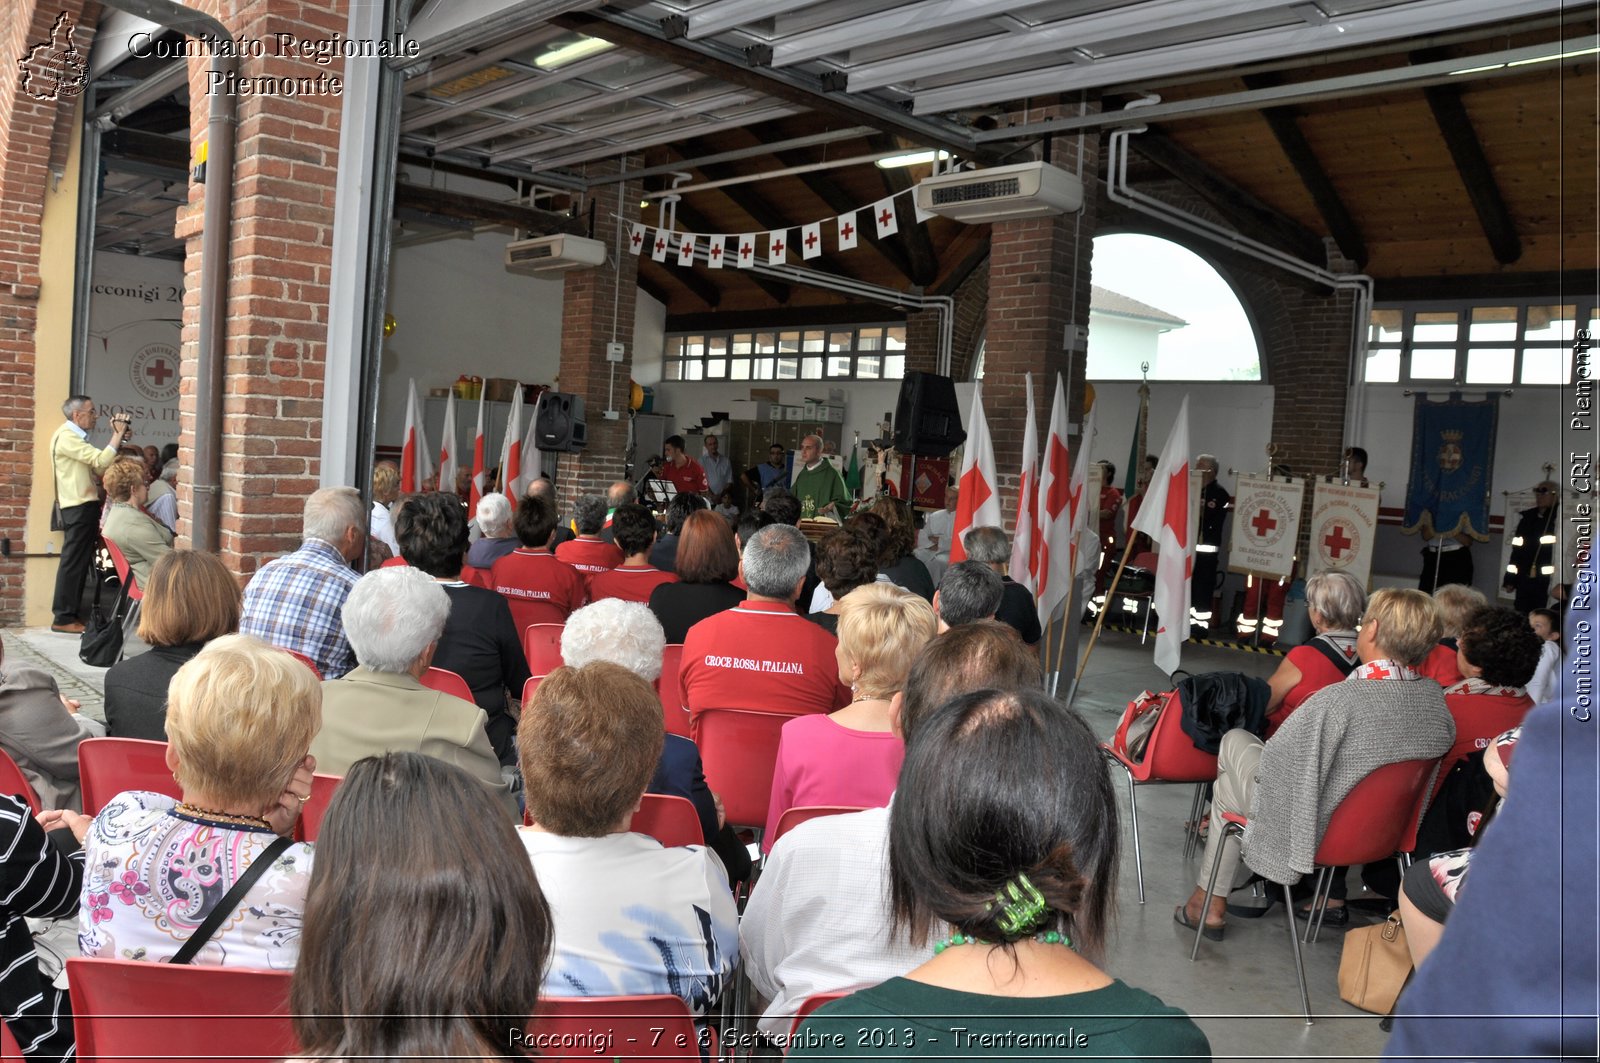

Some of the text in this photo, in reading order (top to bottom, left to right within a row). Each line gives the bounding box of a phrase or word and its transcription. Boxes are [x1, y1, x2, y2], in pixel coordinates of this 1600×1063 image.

[496, 585, 551, 599] CROCE ROSSA ITALIANA
[704, 655, 803, 674] CROCE ROSSA ITALIANA
